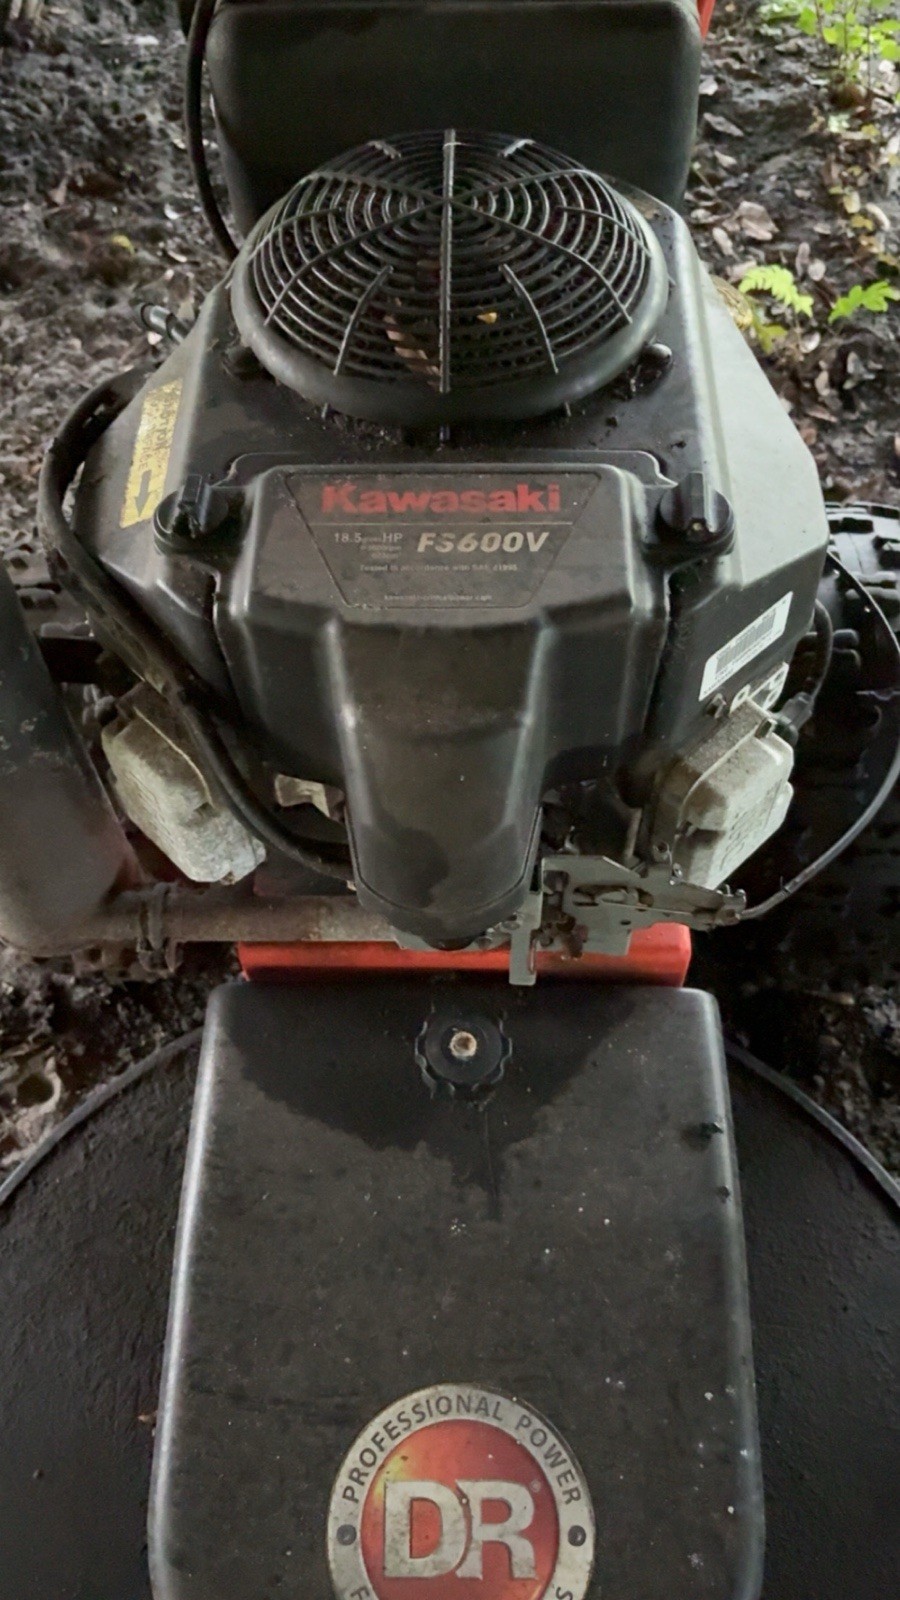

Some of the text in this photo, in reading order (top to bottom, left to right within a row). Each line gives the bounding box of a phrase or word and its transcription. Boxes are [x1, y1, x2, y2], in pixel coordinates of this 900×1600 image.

[322, 483, 561, 513] Kawasaki
[334, 532, 361, 543] 18.5
[382, 532, 403, 544] HP
[417, 532, 550, 553] FS600V
[342, 1394, 582, 1505] PROFESSIONAL POWER
[382, 1479, 537, 1580] DR
